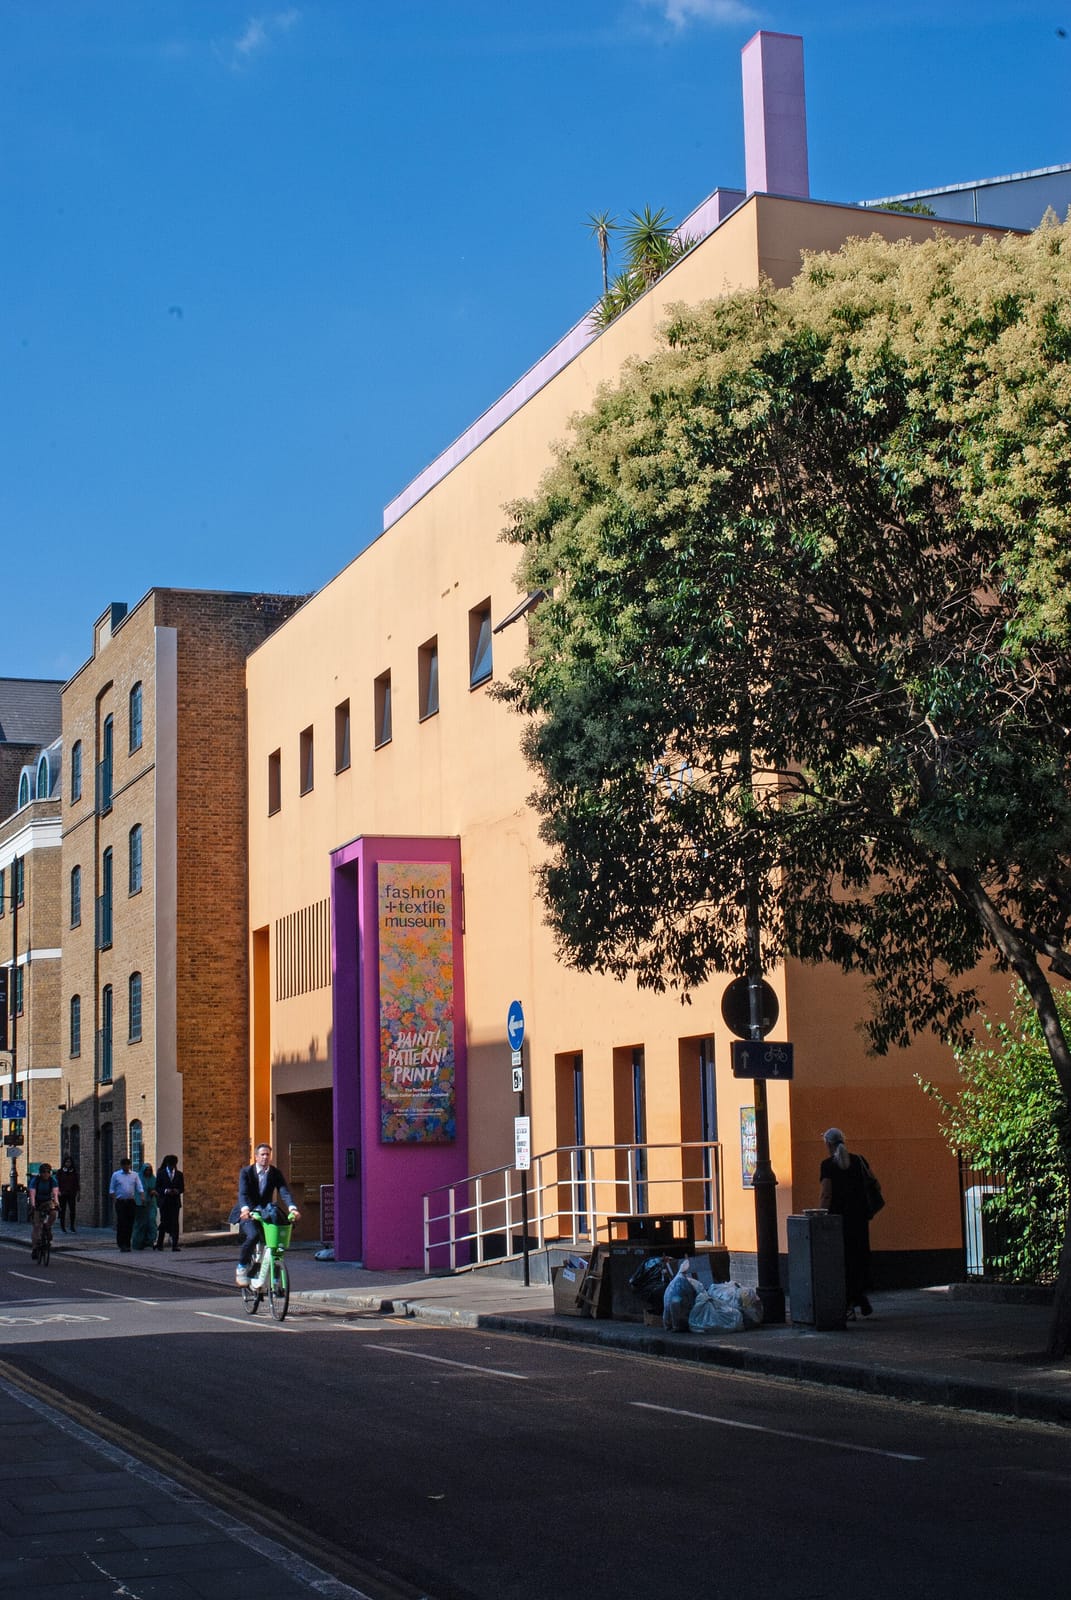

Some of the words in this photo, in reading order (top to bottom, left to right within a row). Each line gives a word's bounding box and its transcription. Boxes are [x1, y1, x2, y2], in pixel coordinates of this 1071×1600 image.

[385, 885, 445, 898] fashion
[385, 900, 445, 913] +textile
[385, 917, 446, 927] museum
[394, 1029, 441, 1048] PAINT!
[388, 1047, 448, 1067] PATTERN!
[393, 1064, 440, 1083] PRINT!
